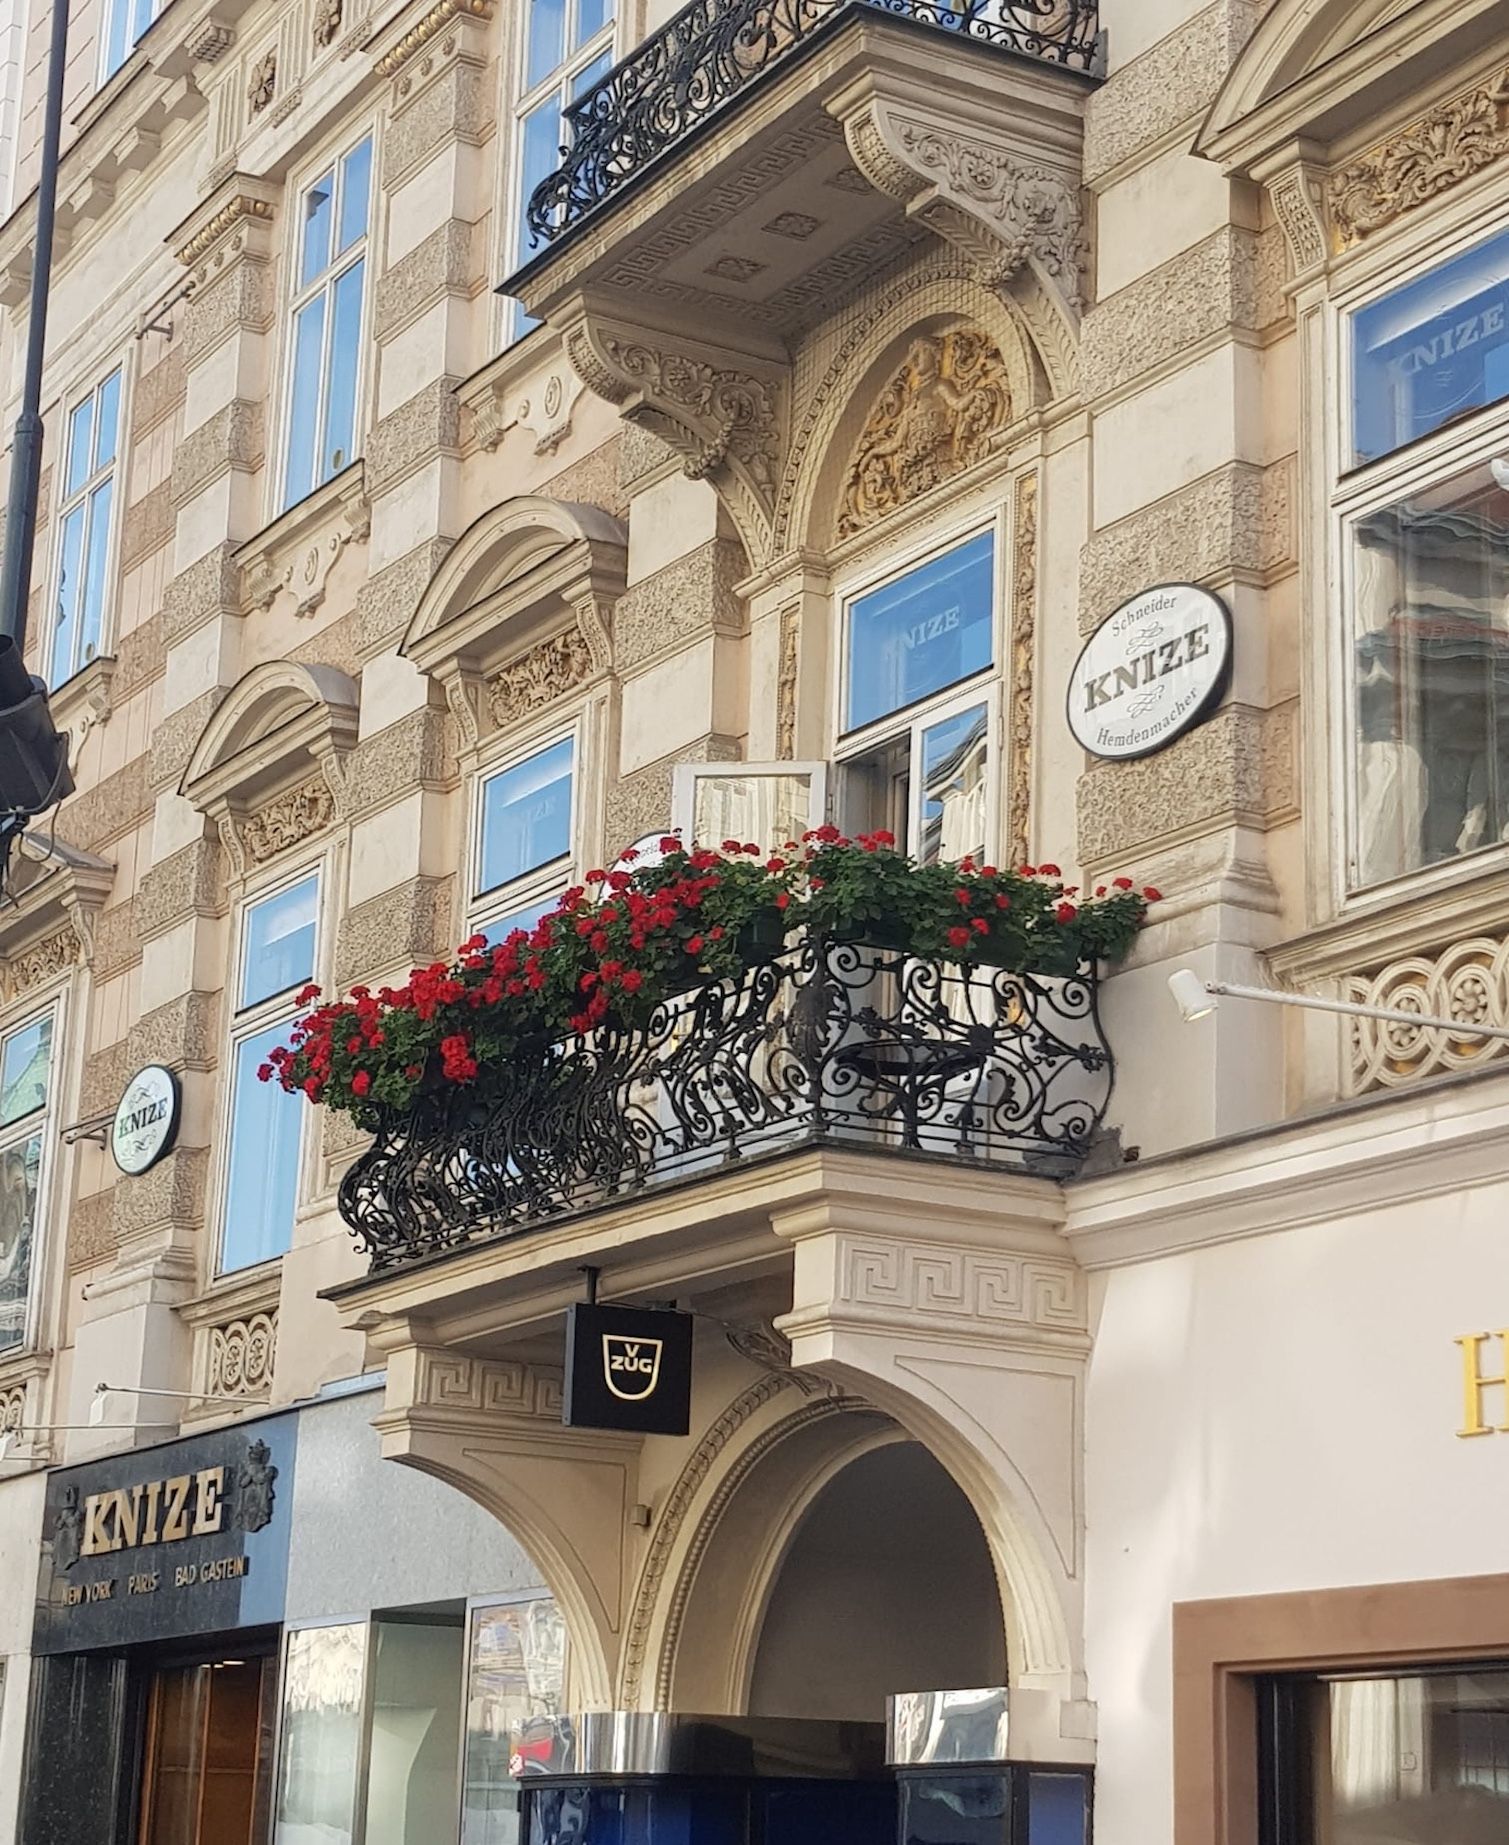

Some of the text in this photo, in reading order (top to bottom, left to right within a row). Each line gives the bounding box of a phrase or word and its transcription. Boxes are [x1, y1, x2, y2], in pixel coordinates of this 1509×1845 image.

[1112, 595, 1177, 637] Schneider
[1084, 623, 1210, 713] KNIZE
[1097, 687, 1198, 747] Hemdenmacher
[118, 1097, 168, 1139] KNIZE
[611, 1355, 653, 1373] ZUG
[80, 1466, 225, 1556] KNIZE
[62, 1556, 245, 1607] NEW YORK PARIS BAD GASTEIN
